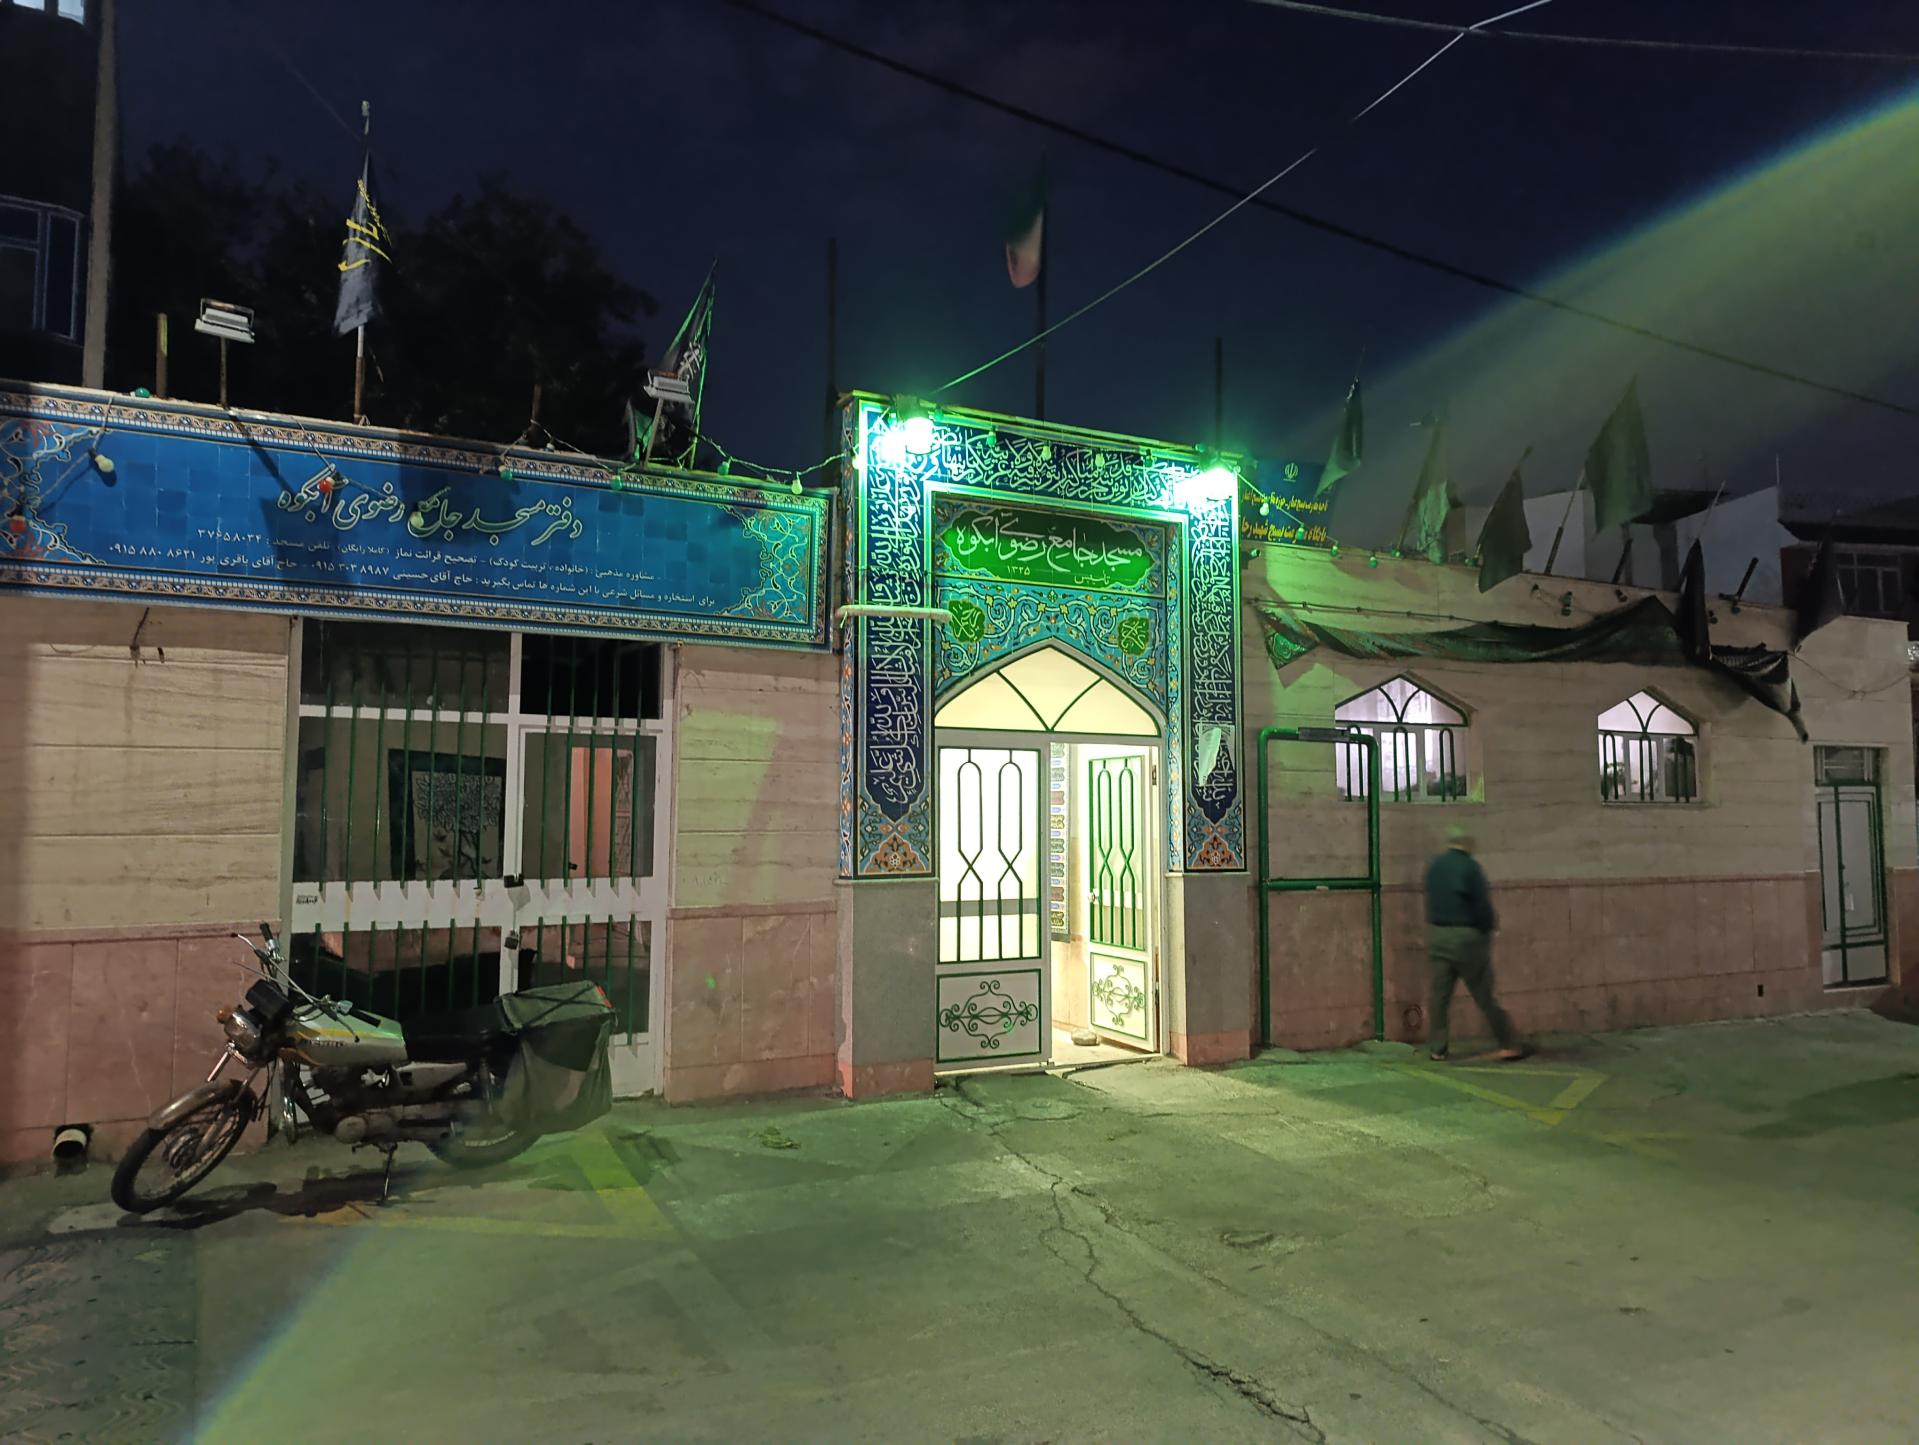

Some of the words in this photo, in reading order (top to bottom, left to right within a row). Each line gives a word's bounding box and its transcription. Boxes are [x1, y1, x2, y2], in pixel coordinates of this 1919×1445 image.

[333, 482, 405, 531] رضوی
[408, 494, 463, 541] جامع
[462, 499, 546, 546] مسجد
[531, 496, 583, 546] دفتر
[998, 516, 1047, 561] رضوی
[308, 540, 330, 551] تلفن
[1047, 527, 1094, 573] جامع
[200, 554, 215, 564] پور
[395, 548, 412, 560] نماز
[1091, 541, 1142, 572] مسجد
[219, 554, 249, 567] باقری
[252, 554, 274, 568] آقای
[276, 557, 297, 570] حاج
[444, 555, 478, 566] تصحیح
[392, 571, 429, 581] حسینی
[430, 570, 451, 583] آقای
[454, 573, 473, 585] حاج
[625, 571, 655, 581] مشاوره
[512, 580, 536, 590] تماس
[550, 582, 576, 594] شماره
[578, 585, 592, 596] این
[602, 588, 628, 598] شرعی
[664, 593, 695, 604] استخاره
[698, 595, 715, 607] برای
